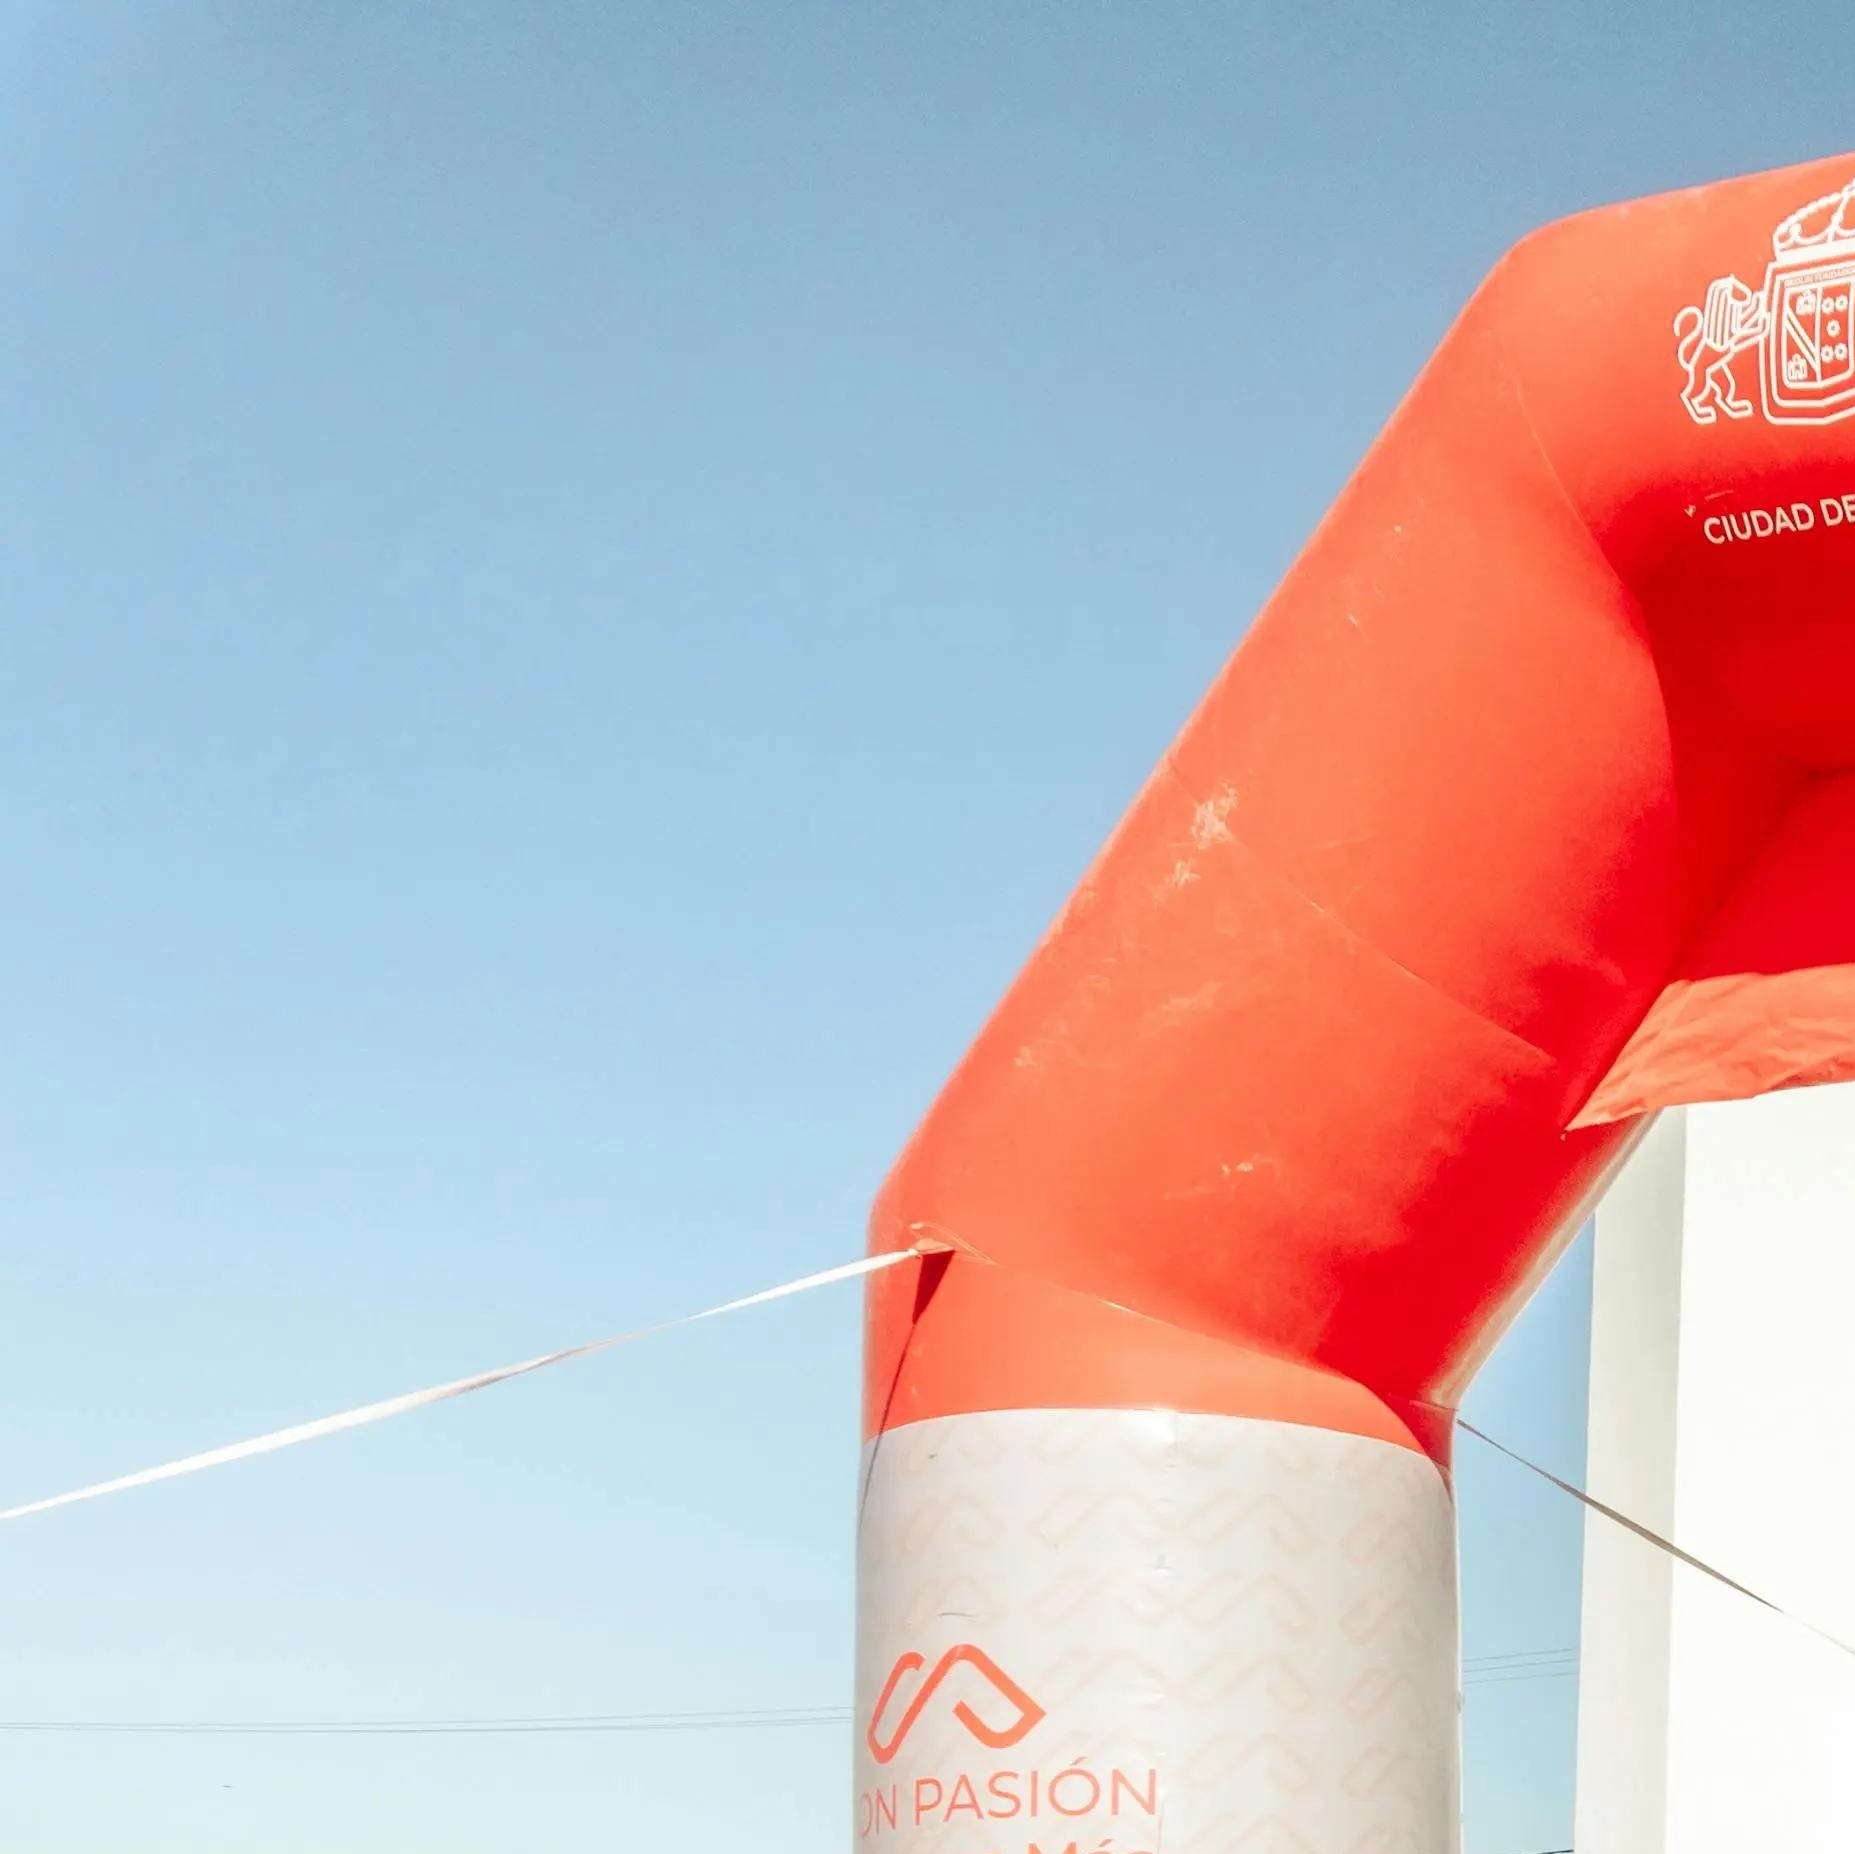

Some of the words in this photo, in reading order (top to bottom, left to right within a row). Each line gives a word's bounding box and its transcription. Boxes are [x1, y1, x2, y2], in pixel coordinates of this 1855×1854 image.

[1703, 502, 1815, 545] CIUDAD
[858, 1783, 897, 1838] ON
[914, 1756, 1157, 1826] PASIÓN
